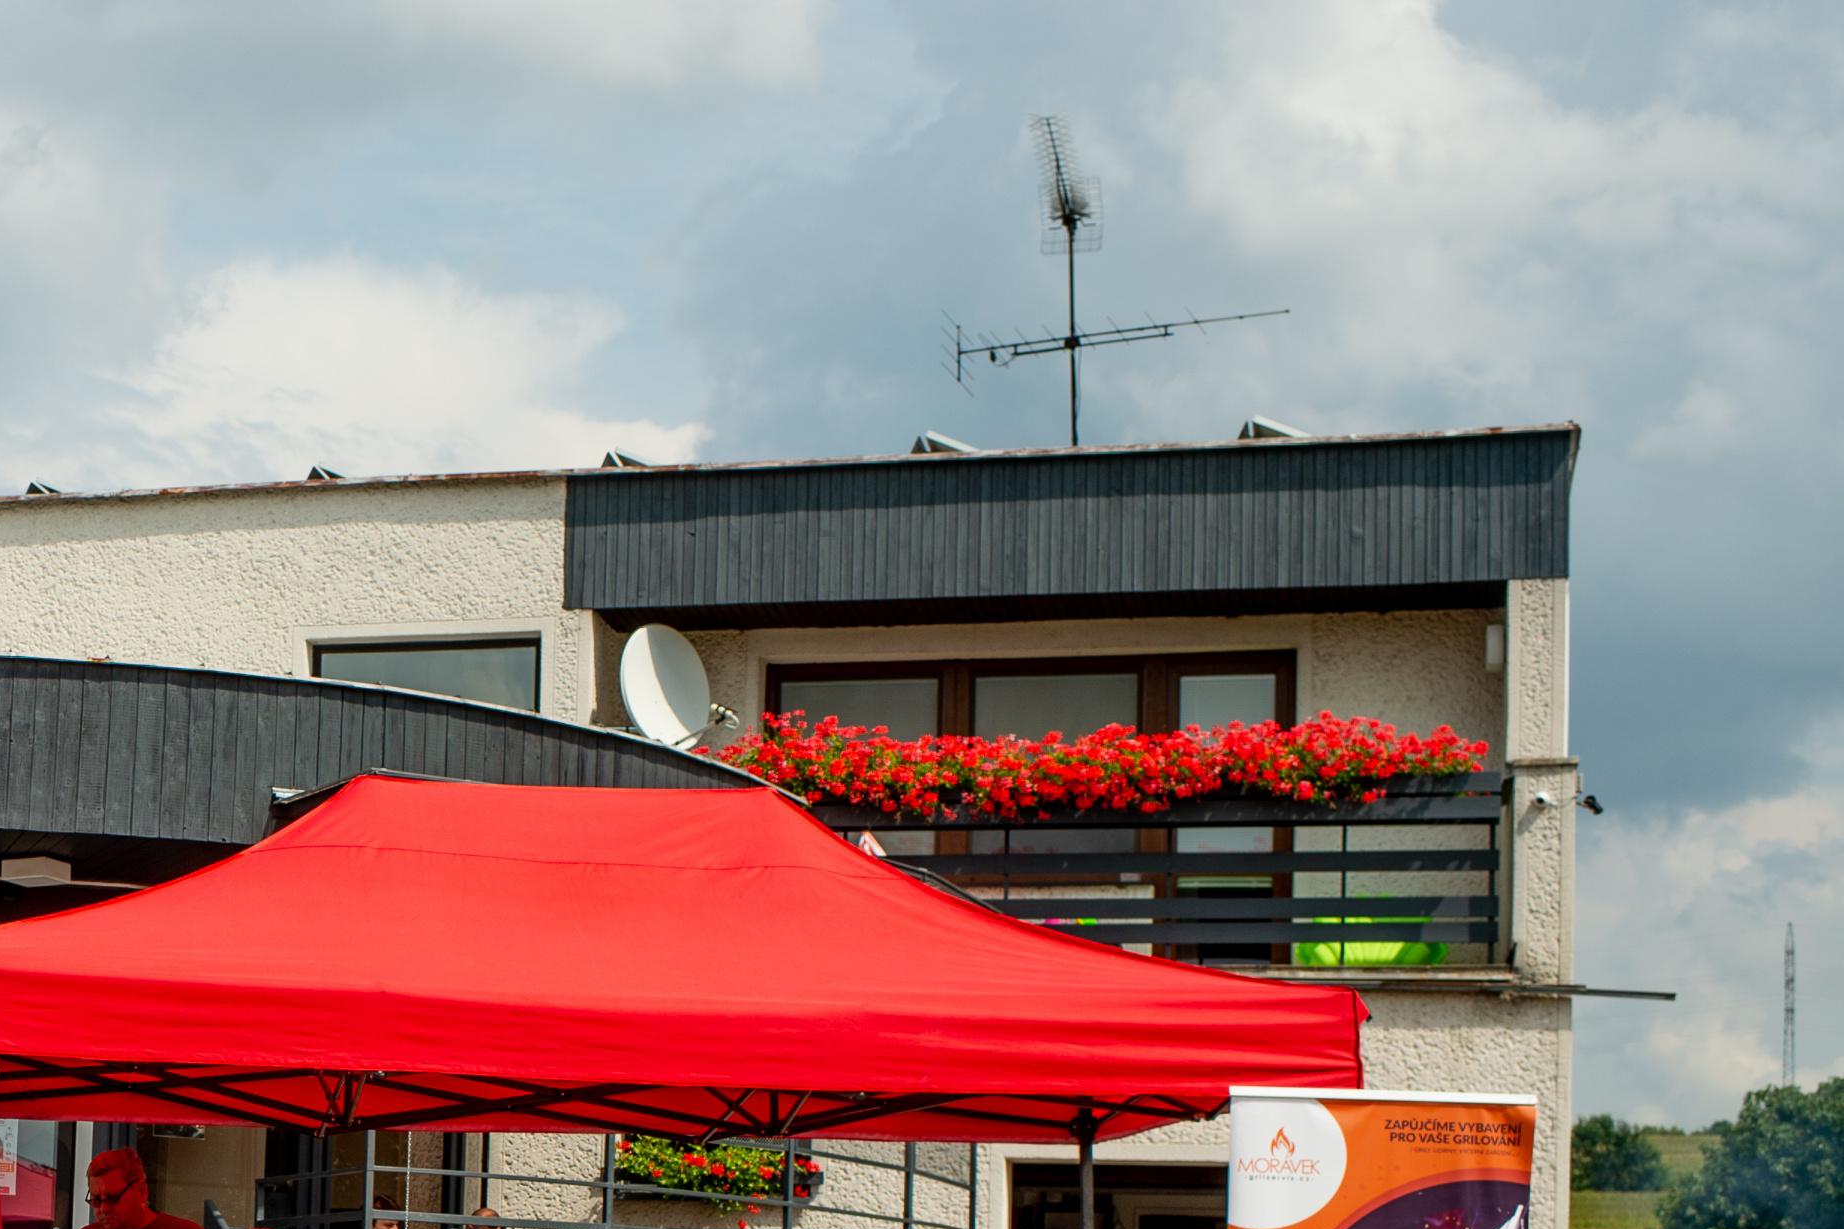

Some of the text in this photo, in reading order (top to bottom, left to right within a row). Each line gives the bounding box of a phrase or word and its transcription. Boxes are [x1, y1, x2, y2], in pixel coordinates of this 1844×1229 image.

[1384, 1118, 1523, 1135] ZAPŮJČÍME VYBAVENÍ
[1390, 1131, 1521, 1147] PRO VAŠE GRILOVÁNÍ
